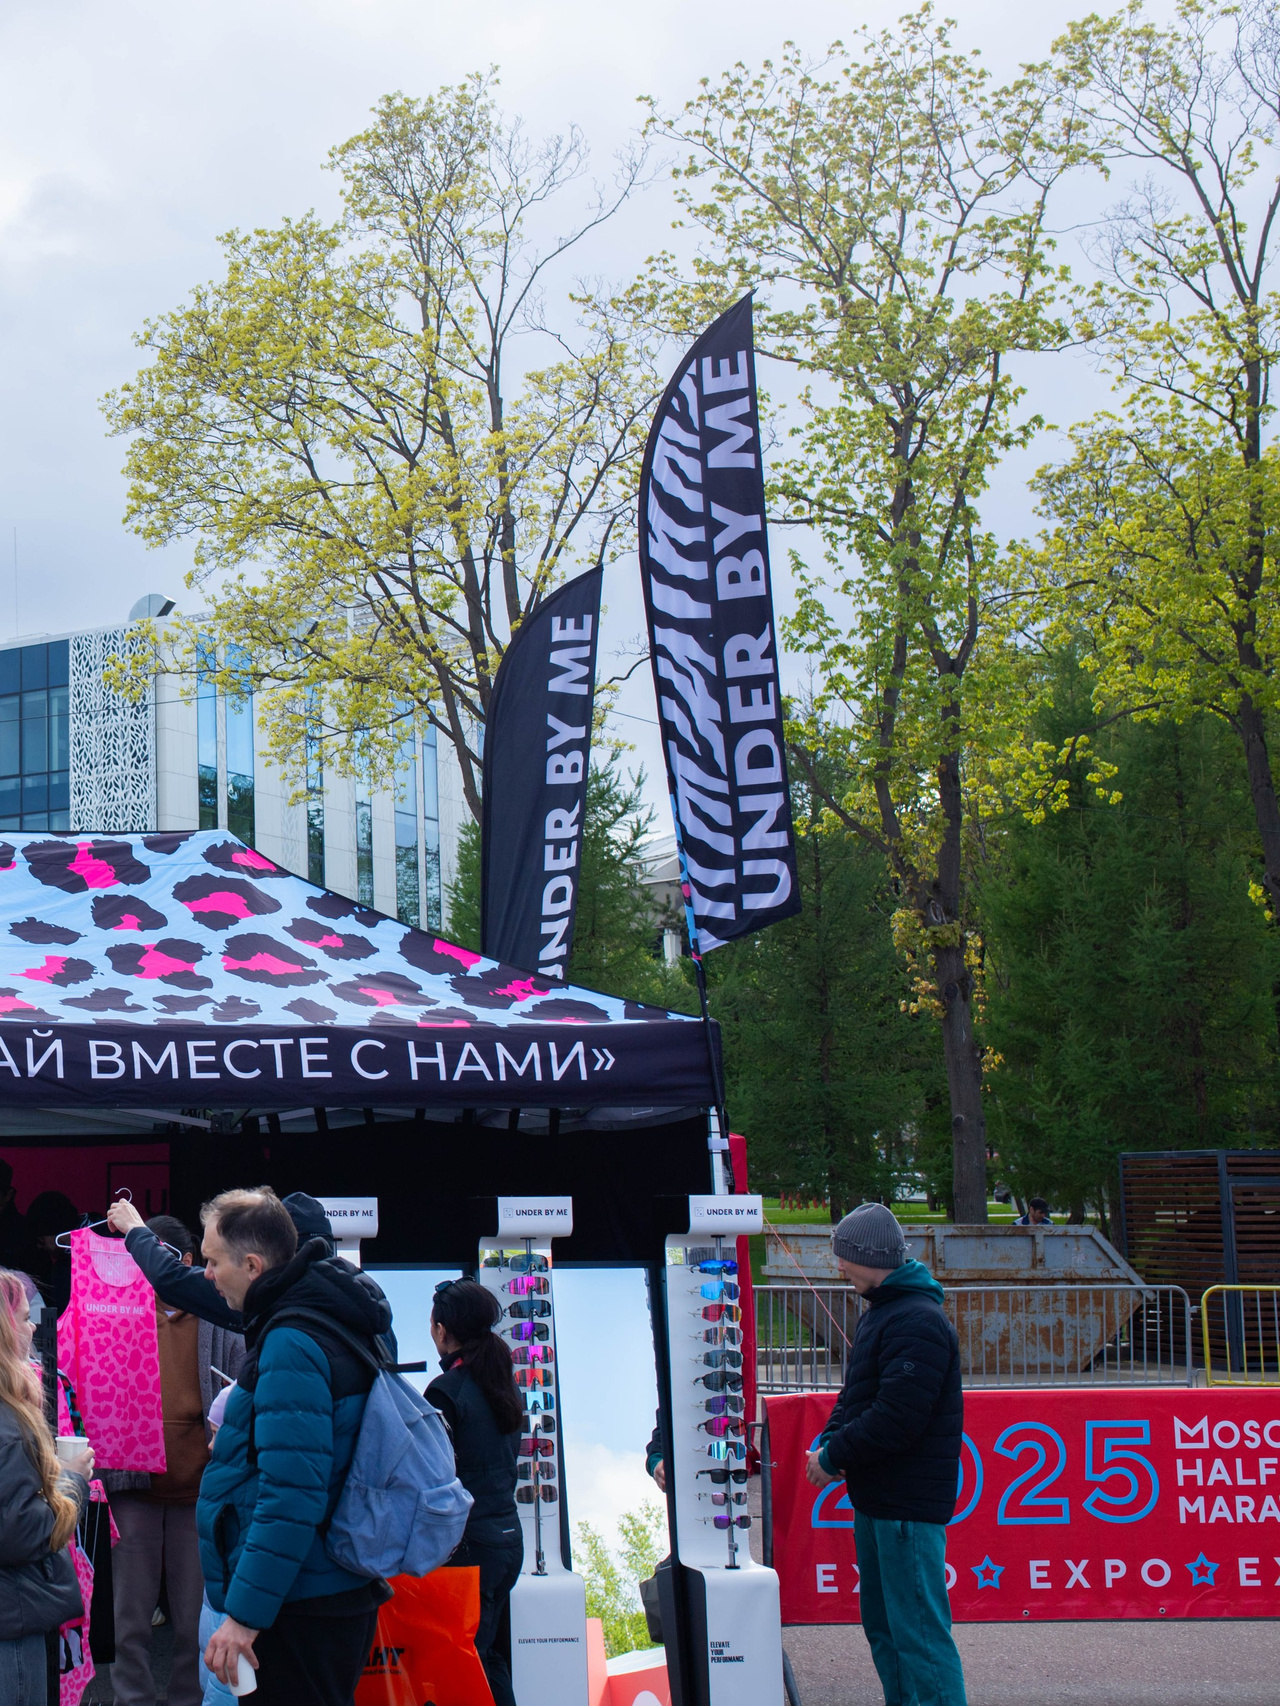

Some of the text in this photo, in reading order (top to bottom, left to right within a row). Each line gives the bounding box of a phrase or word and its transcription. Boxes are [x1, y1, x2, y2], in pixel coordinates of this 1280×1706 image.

[703, 348, 793, 911] UNDER BY ME
[547, 613, 593, 696] ME
[546, 711, 588, 785] BY
[88, 1037, 333, 1080] ВМЕСТЕ
[350, 1039, 389, 1080] С
[407, 1040, 616, 1082] НАМИ»
[349, 1209, 360, 1217] BY
[361, 1209, 374, 1217] ME
[515, 1208, 543, 1217] UNDER
[544, 1208, 555, 1216] BY
[556, 1208, 568, 1216] ME
[706, 1208, 733, 1216] UNDER
[734, 1208, 745, 1216] BY
[746, 1208, 758, 1216] ME
[86, 1303, 145, 1315] UNDER BY ME
[1176, 1457, 1279, 1487] HALF
[1178, 1494, 1280, 1524] MARA
[1029, 1558, 1172, 1590] EXPO
[710, 1655, 745, 1663] PERFORMANCE
